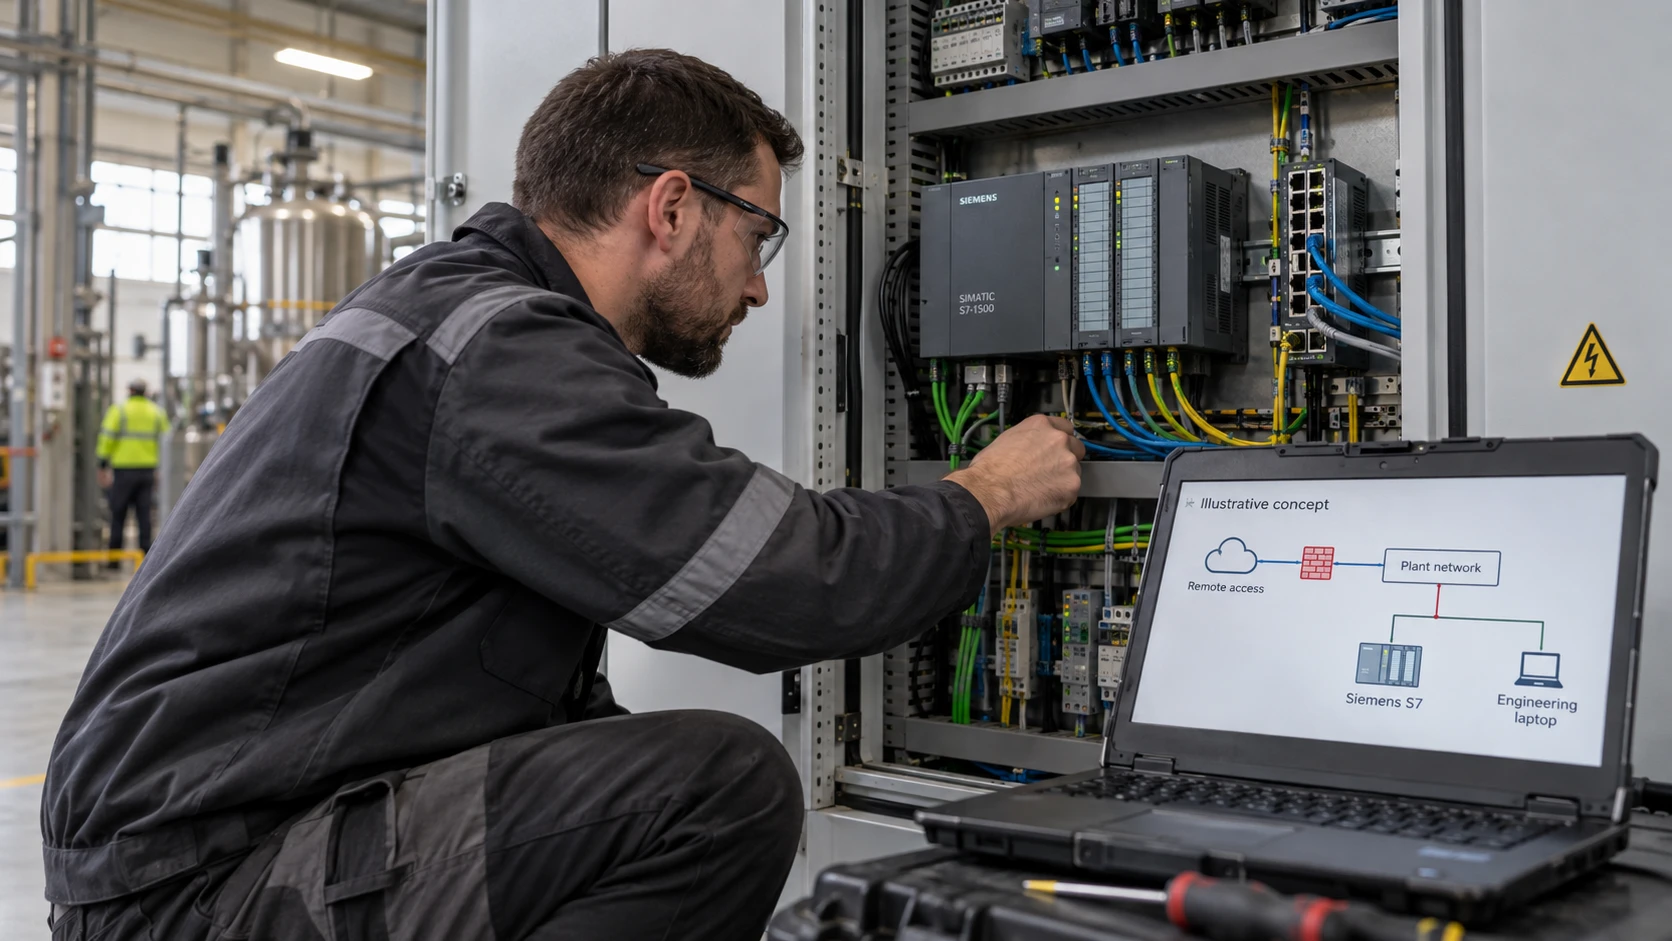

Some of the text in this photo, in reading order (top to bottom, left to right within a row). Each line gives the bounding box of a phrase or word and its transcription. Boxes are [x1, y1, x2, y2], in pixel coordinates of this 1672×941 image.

[959, 193, 998, 205] SIEMENS
[959, 291, 996, 303] SIMATIC
[1200, 497, 1330, 514] Illustrative concept
[1400, 560, 1482, 573] Plant network
[1187, 580, 1265, 594] Remote access
[1345, 692, 1424, 709] Siemens S7
[1497, 693, 1578, 713] Engineering
[1514, 711, 1558, 729] laptop
